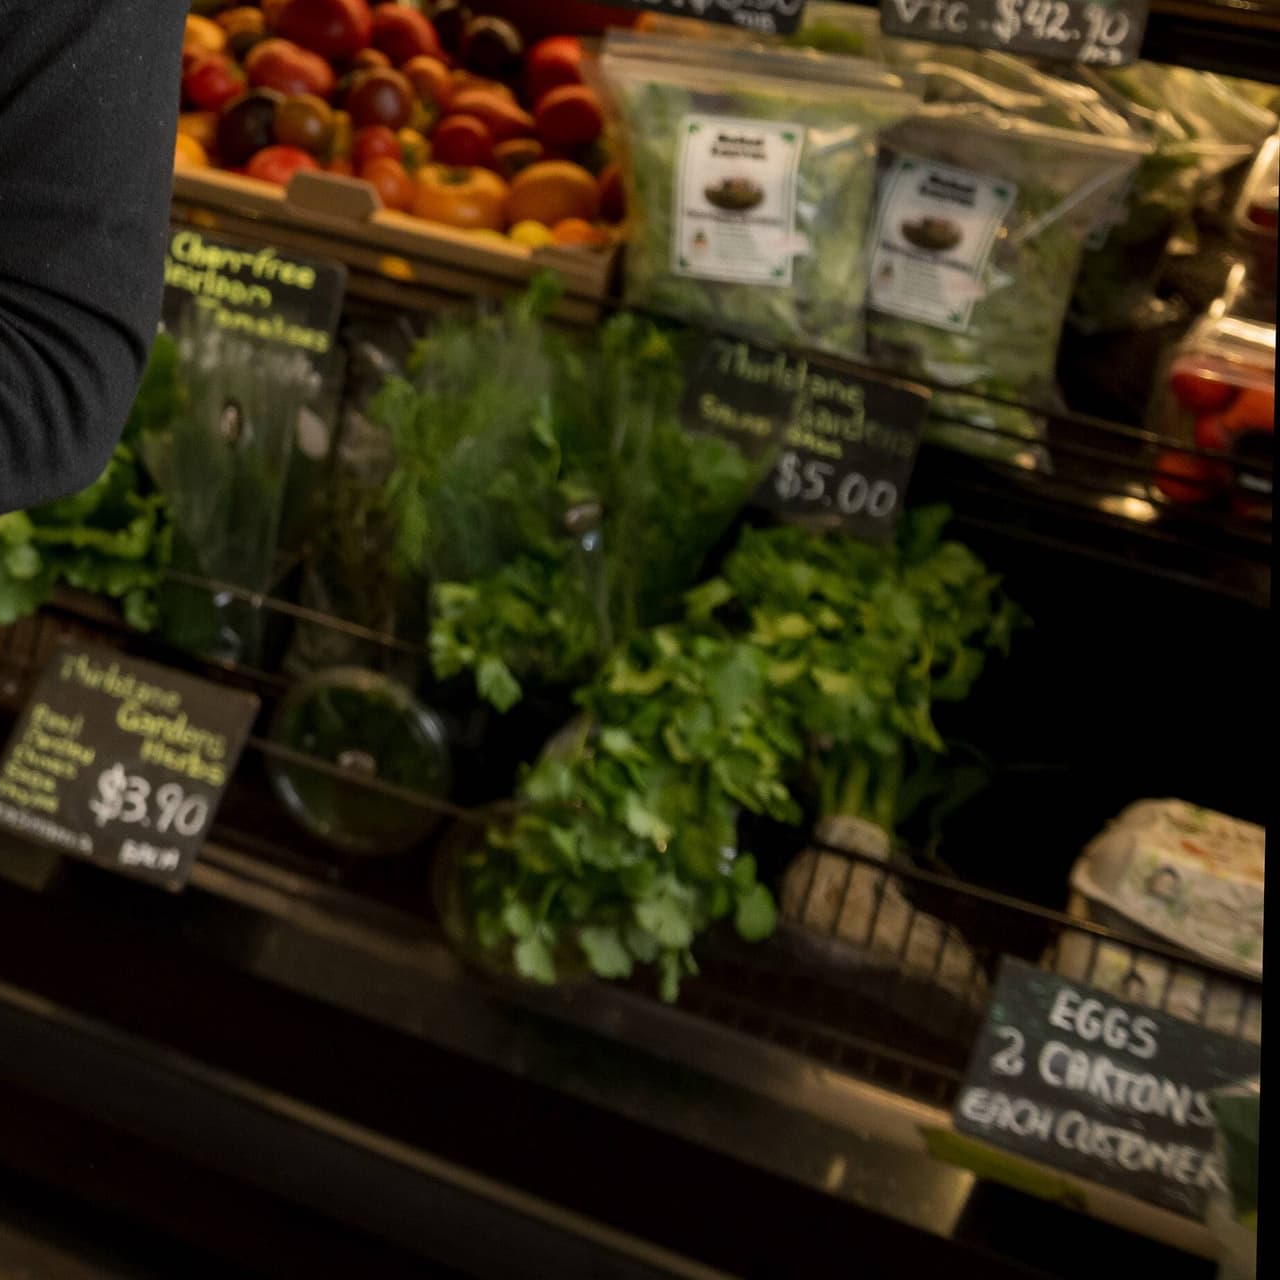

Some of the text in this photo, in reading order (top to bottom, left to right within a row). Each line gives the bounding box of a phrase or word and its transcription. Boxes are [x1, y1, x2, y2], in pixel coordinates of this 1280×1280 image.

[774, 450, 898, 519] $5.00
[89, 761, 209, 837] $3.90
[1048, 987, 1161, 1060] EGGS
[991, 1025, 1216, 1128] 2 CARTONS
[959, 1086, 1232, 1194] EACH CUSTOMER
